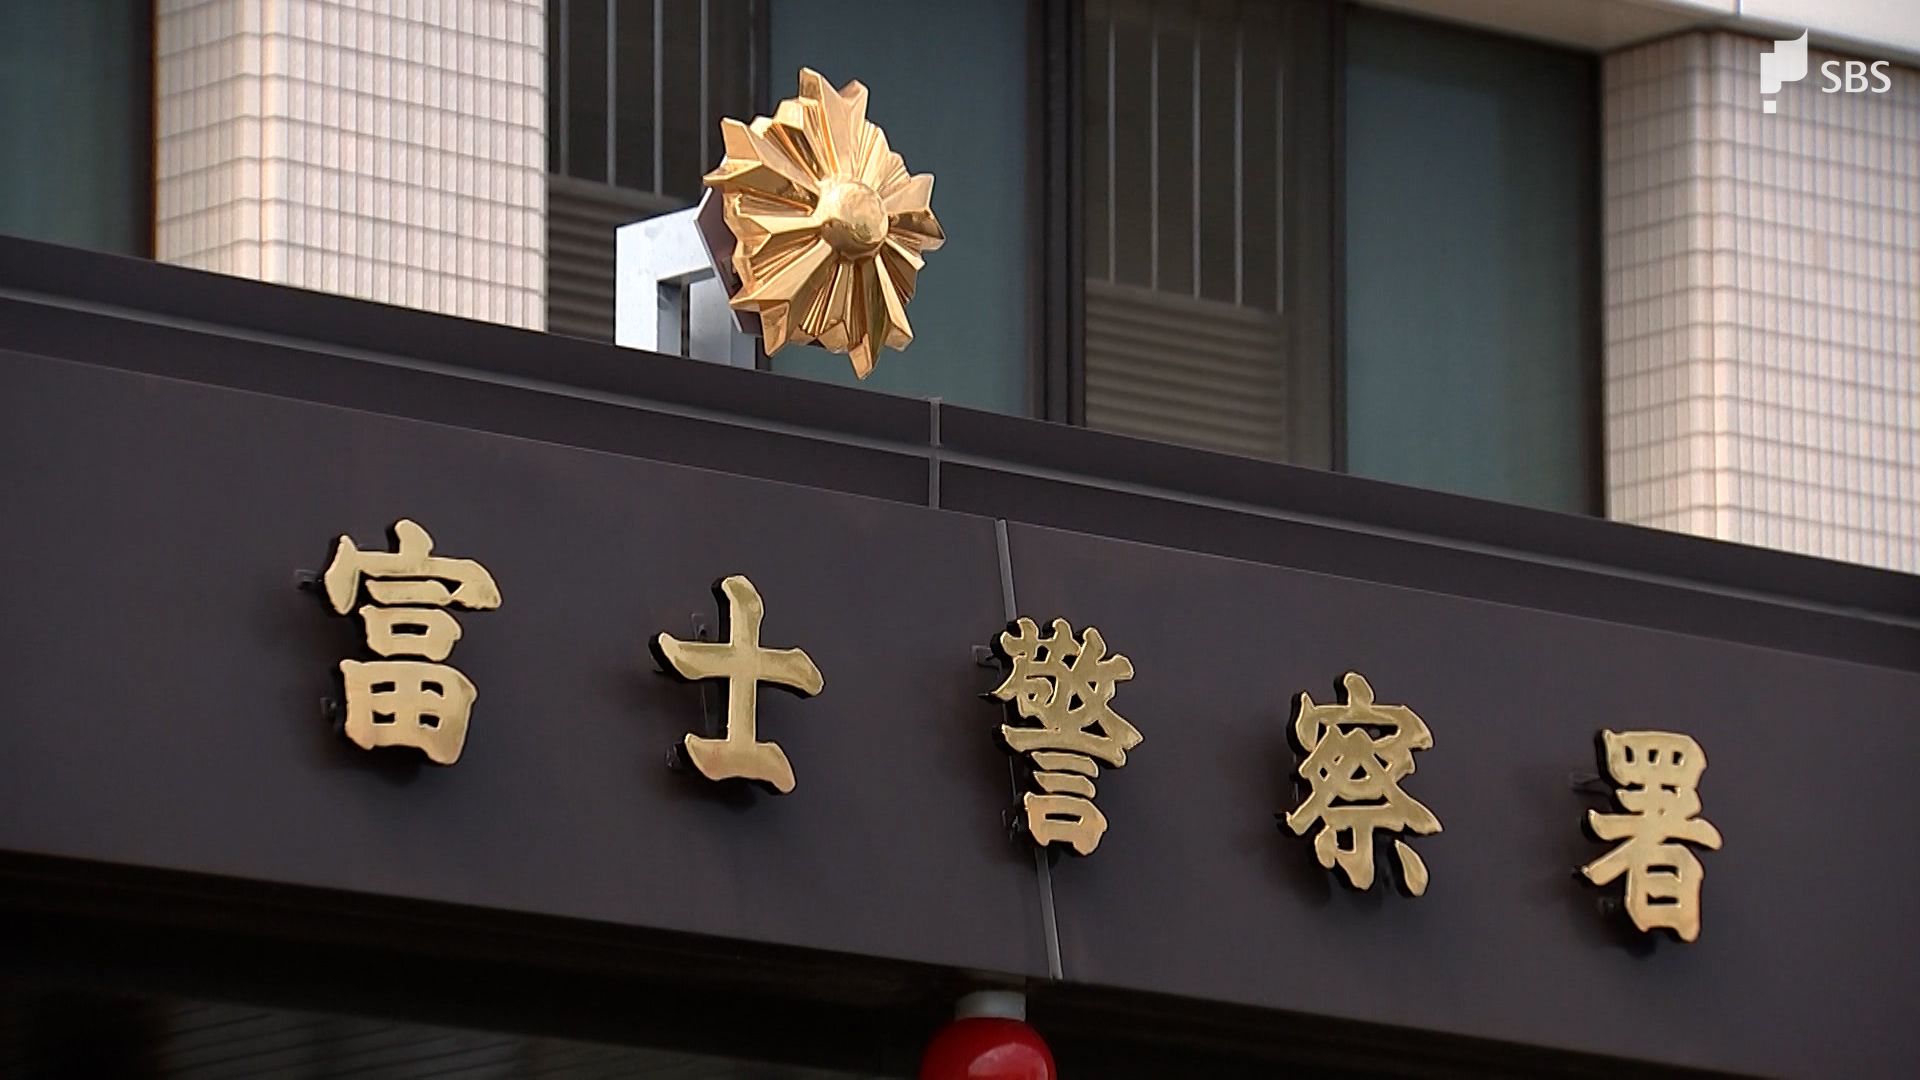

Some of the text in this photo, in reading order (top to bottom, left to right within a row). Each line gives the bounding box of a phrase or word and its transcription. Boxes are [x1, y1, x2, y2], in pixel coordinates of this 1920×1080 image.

[323, 518, 1723, 943] 富士警察署
